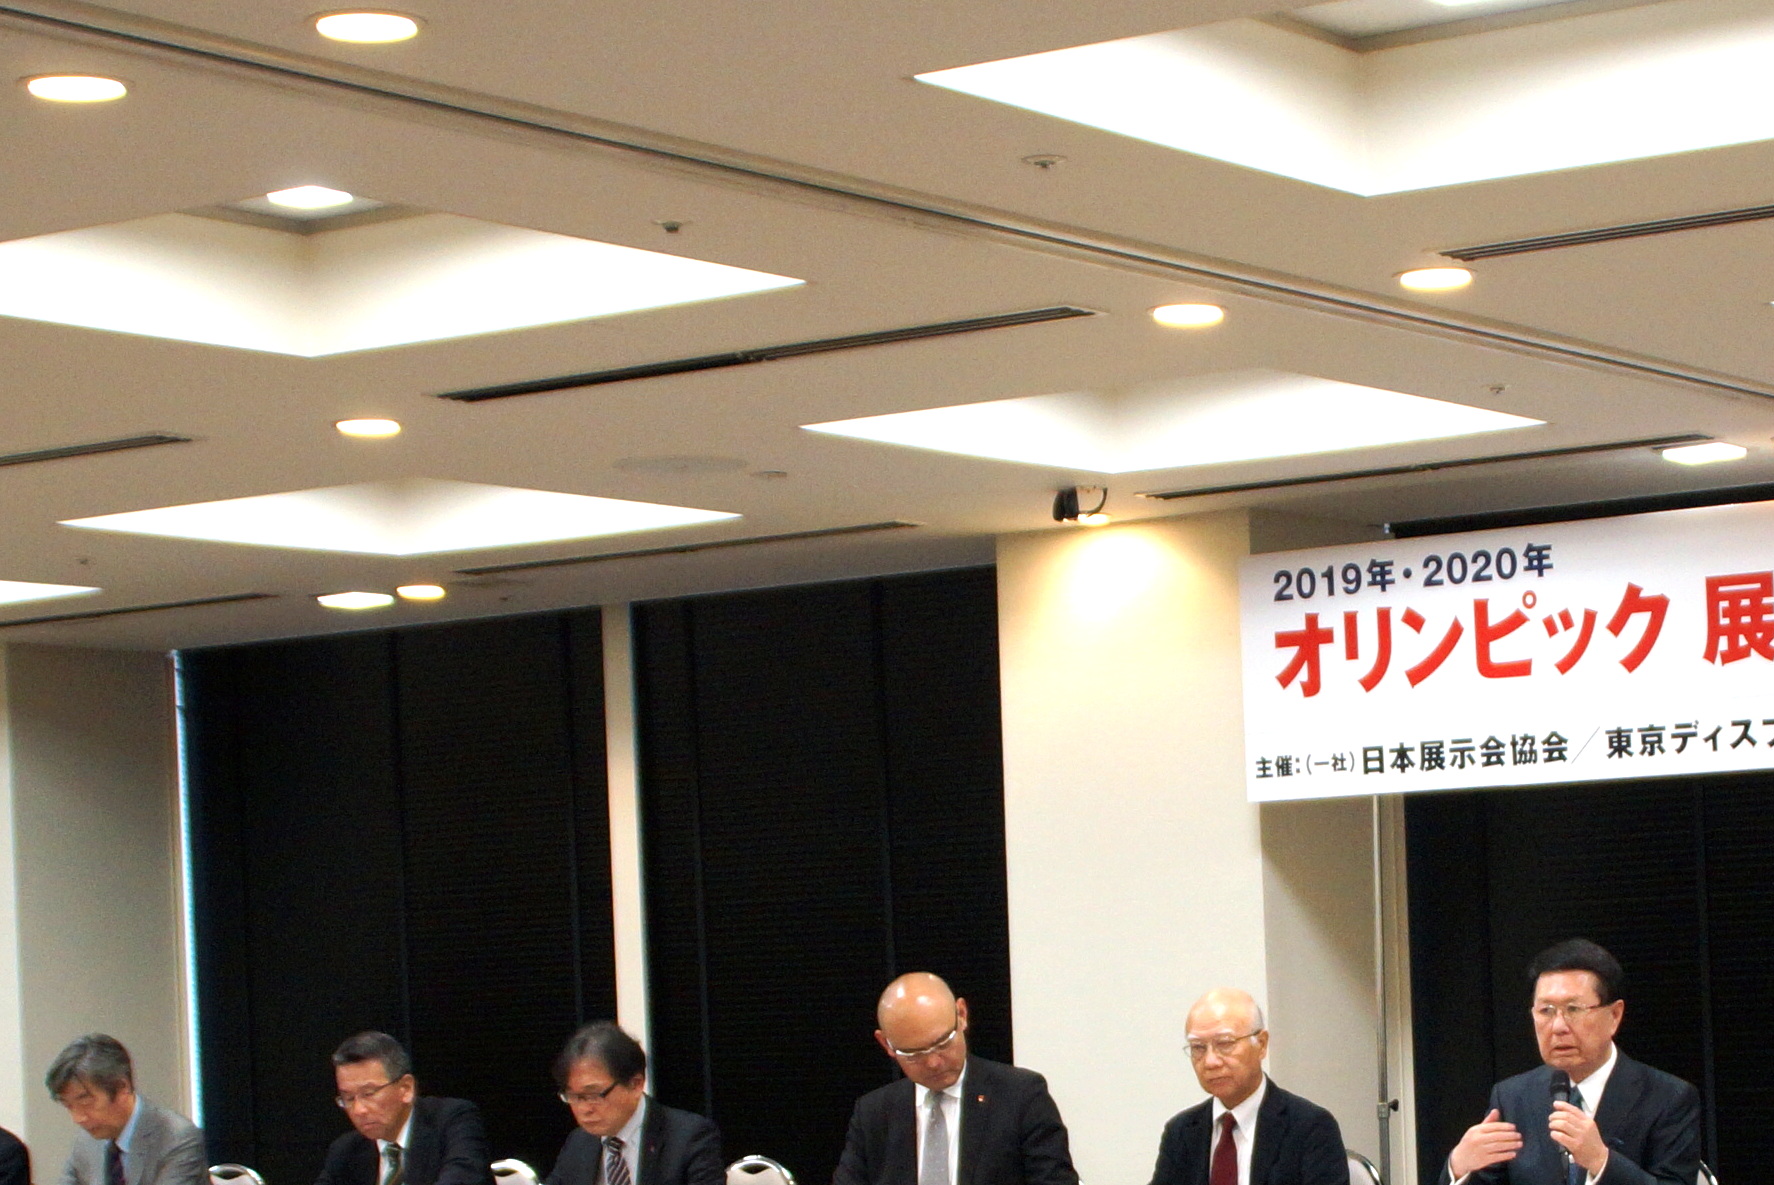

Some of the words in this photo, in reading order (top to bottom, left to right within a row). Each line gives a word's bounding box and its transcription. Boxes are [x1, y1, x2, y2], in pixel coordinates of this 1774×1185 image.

[1273, 542, 1554, 602] 2019年・2020年
[1274, 581, 1671, 699] オリンピック
